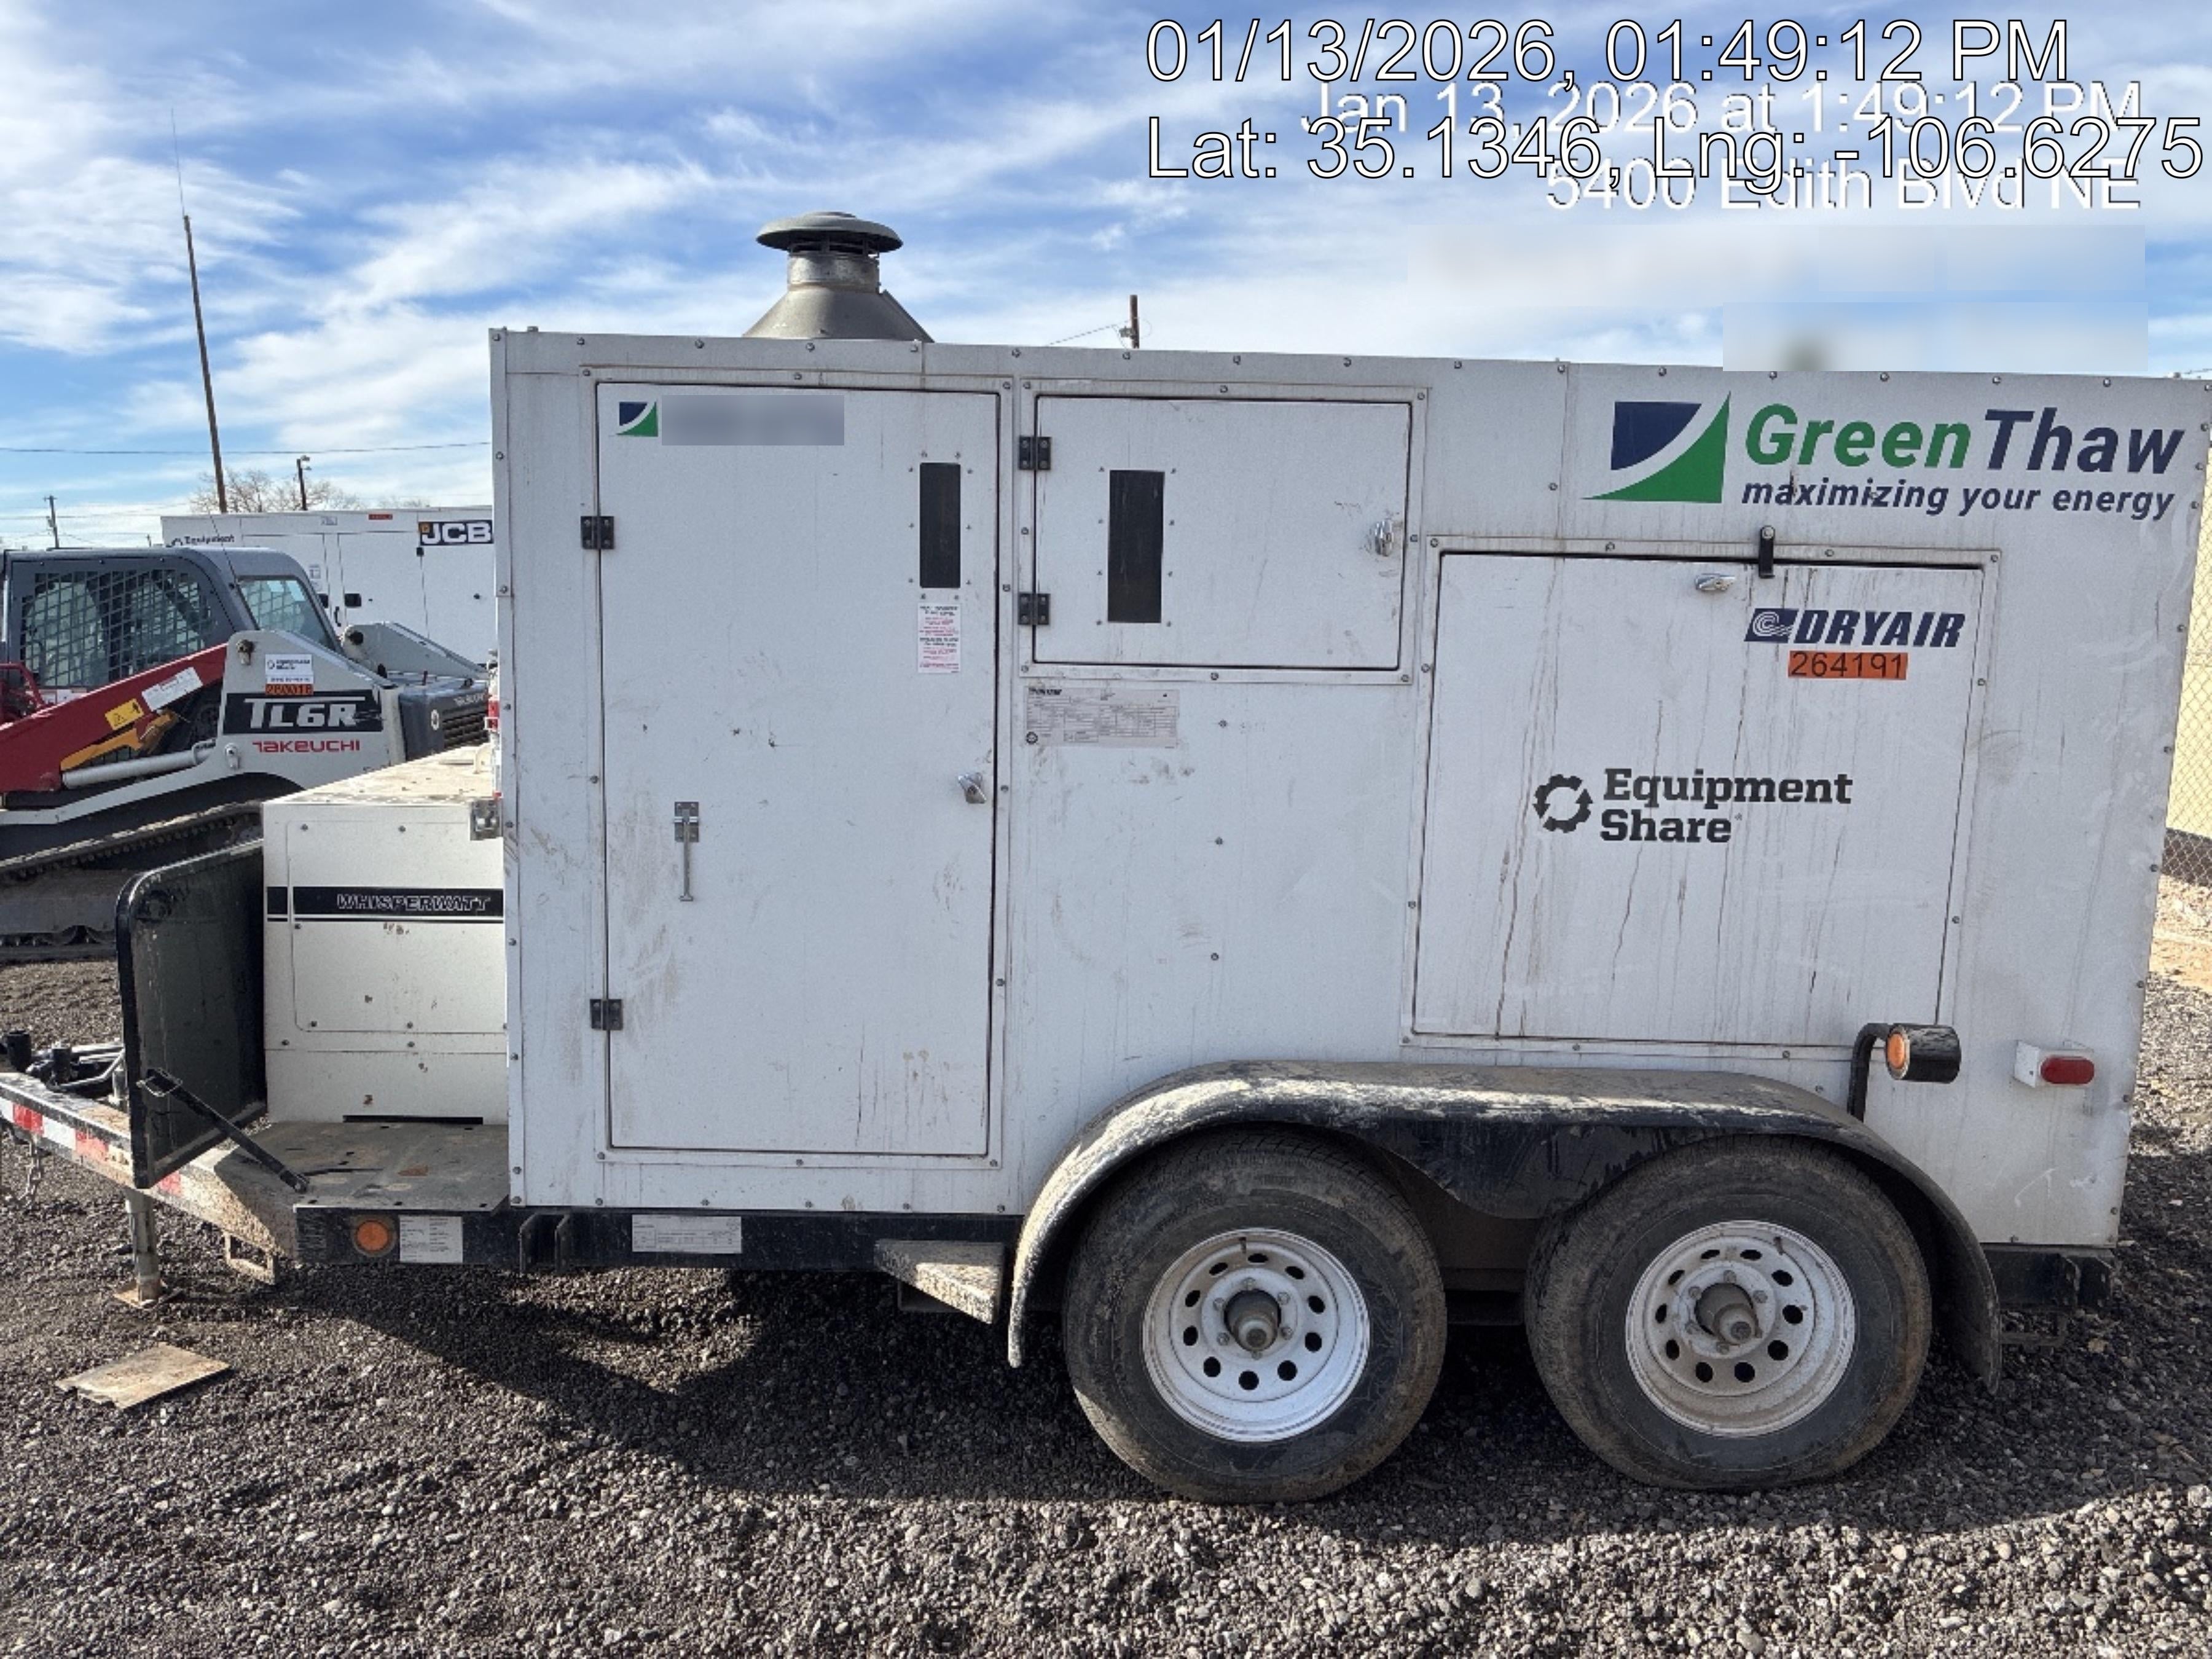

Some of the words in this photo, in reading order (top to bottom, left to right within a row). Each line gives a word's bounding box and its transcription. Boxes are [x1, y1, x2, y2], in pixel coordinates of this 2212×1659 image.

[1742, 477, 1949, 516] maximizing
[1958, 488, 2041, 517] your
[2052, 490, 2175, 521] energy
[422, 522, 492, 544] JCB
[1794, 610, 1966, 648] DRYAIR
[1791, 651, 1902, 679] 264191
[245, 696, 365, 729] TL6R
[1603, 768, 1853, 809] Equipment
[1600, 809, 1732, 842] Share
[337, 893, 490, 911] WHISPERWATT
